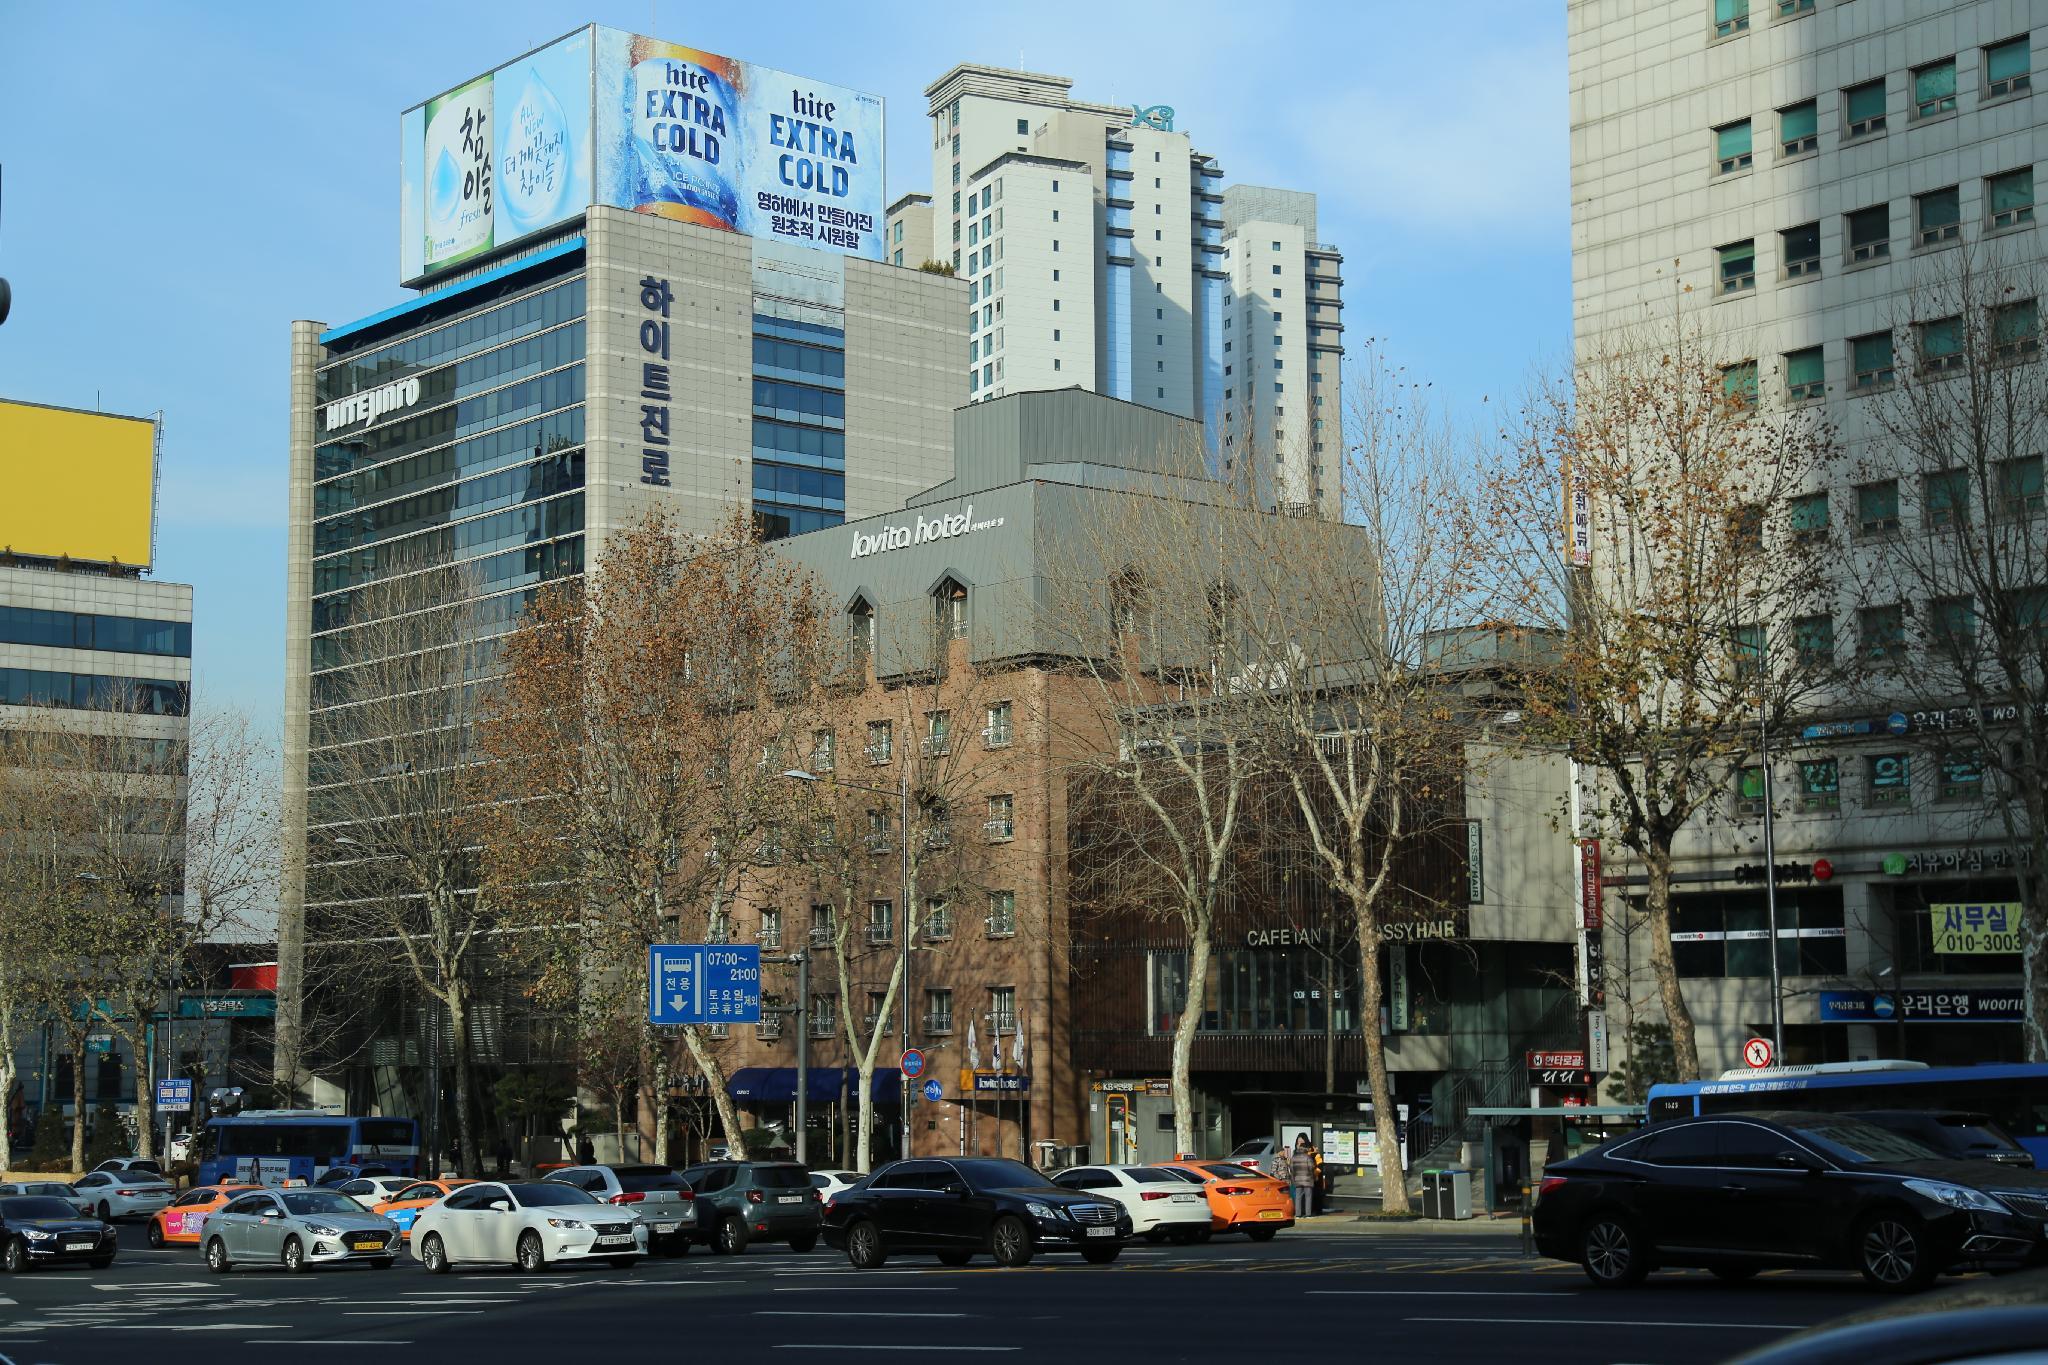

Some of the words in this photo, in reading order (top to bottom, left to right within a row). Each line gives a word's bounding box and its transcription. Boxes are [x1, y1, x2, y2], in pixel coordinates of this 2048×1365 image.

[665, 61, 710, 93] hite
[646, 90, 727, 138] EXTRA
[792, 89, 836, 122] hite
[652, 122, 720, 165] COLD
[770, 113, 857, 164] EXTRA
[460, 107, 491, 215] 참이슬
[779, 154, 849, 198] COLD
[519, 163, 554, 197] 참이슬
[458, 210, 481, 231] fresh
[757, 191, 813, 220] 영하에서
[818, 204, 873, 232] 만들어진
[772, 215, 814, 240] 원초적
[818, 226, 860, 250] 시원함
[639, 275, 675, 487] 하이트진로
[914, 505, 973, 546] hotel
[1471, 870, 1479, 898] HAIR
[1416, 920, 1456, 939] HAIR
[1945, 906, 2006, 932] 사무실
[1247, 929, 1290, 947] CAFE
[1294, 928, 1321, 945] IAN
[1946, 934, 2021, 951] 010-3003
[665, 978, 691, 991] 전용
[730, 968, 758, 981] 21:00
[1393, 963, 1402, 1000] CAFE
[709, 989, 744, 1001] 토요일
[709, 1003, 744, 1015] 공휴일
[744, 995, 758, 1007] 제외
[1902, 995, 1969, 1016] 우리은행
